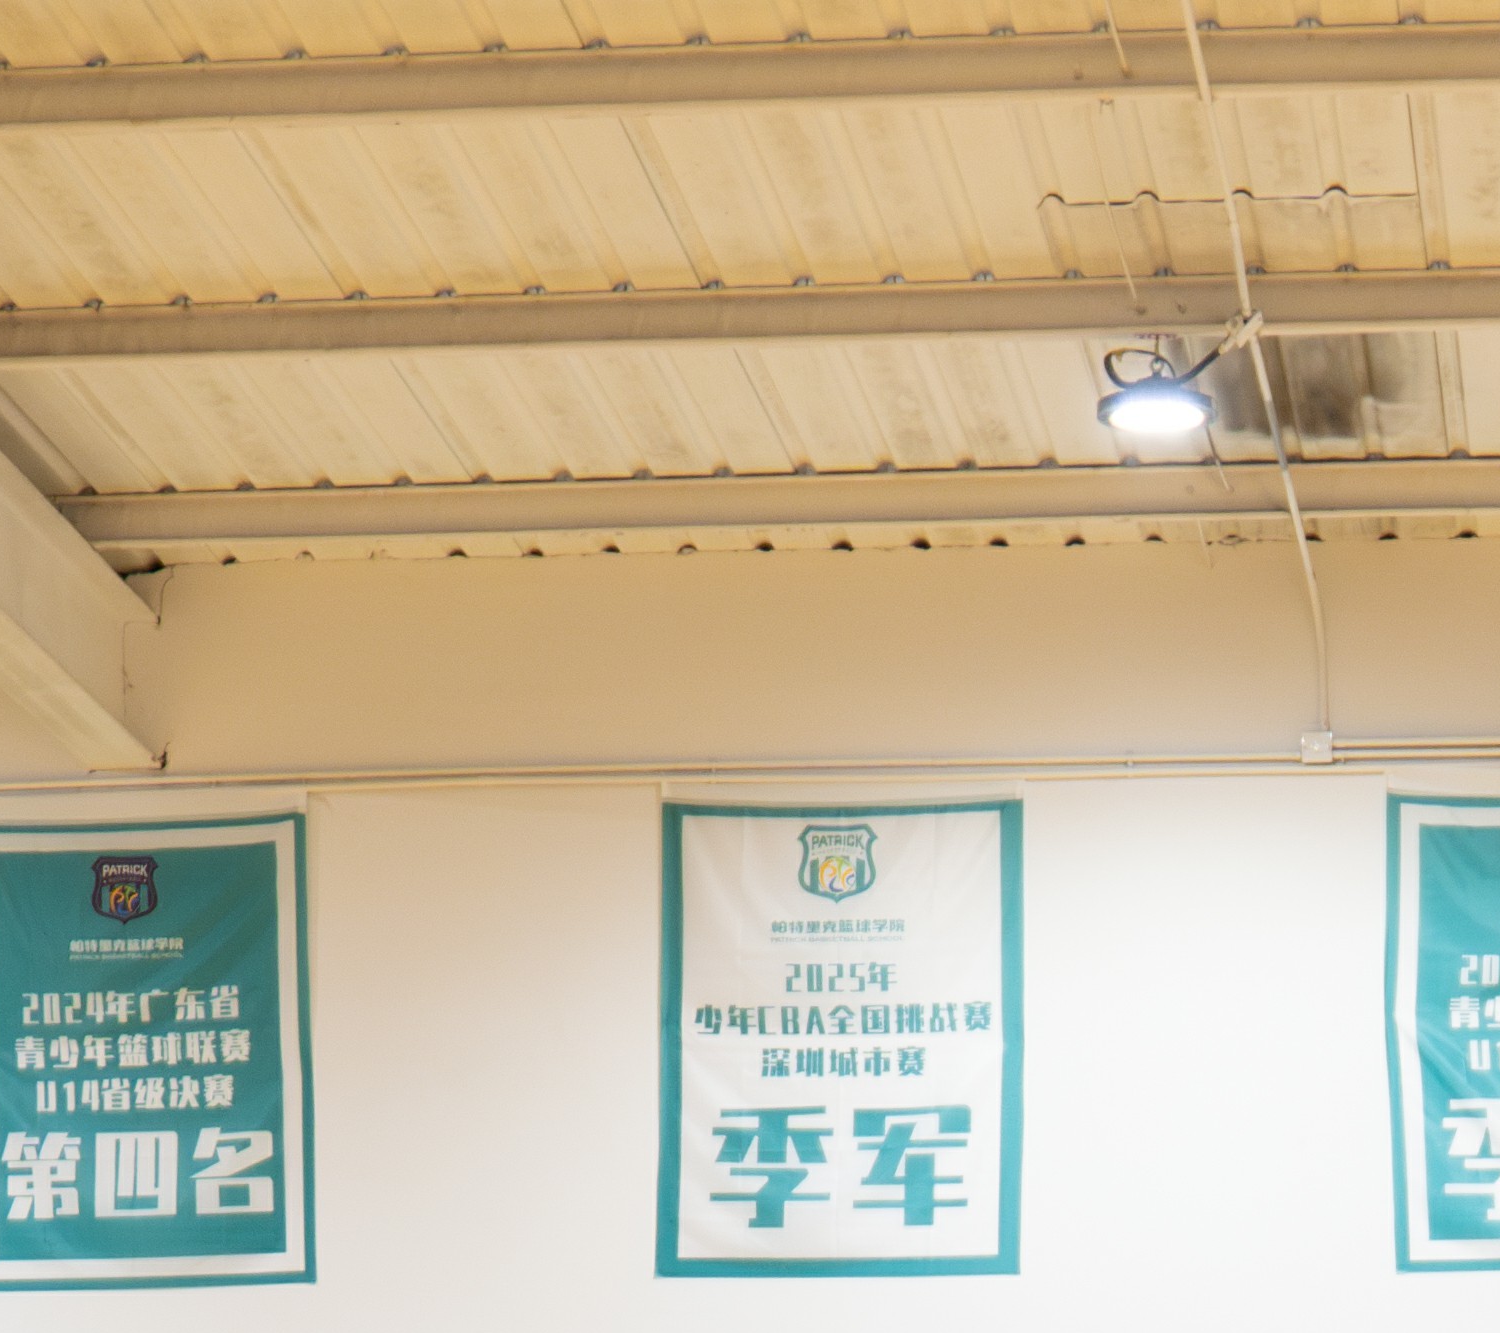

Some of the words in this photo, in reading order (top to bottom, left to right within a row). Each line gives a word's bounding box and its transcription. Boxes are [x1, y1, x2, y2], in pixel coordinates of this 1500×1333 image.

[811, 834, 865, 850] PATRICK
[102, 864, 148, 878] PATRICK
[785, 961, 897, 993] 2025年
[22, 985, 240, 1025] 2024年广东省
[694, 1001, 993, 1036] 少年CBA全国挑战赛
[14, 1029, 251, 1069] 青少年篮球联赛
[761, 1046, 927, 1078] 深圳城市赛
[36, 1074, 235, 1113] U14省级决赛
[1, 1126, 275, 1221] 第四名
[709, 1104, 972, 1229] 季军
